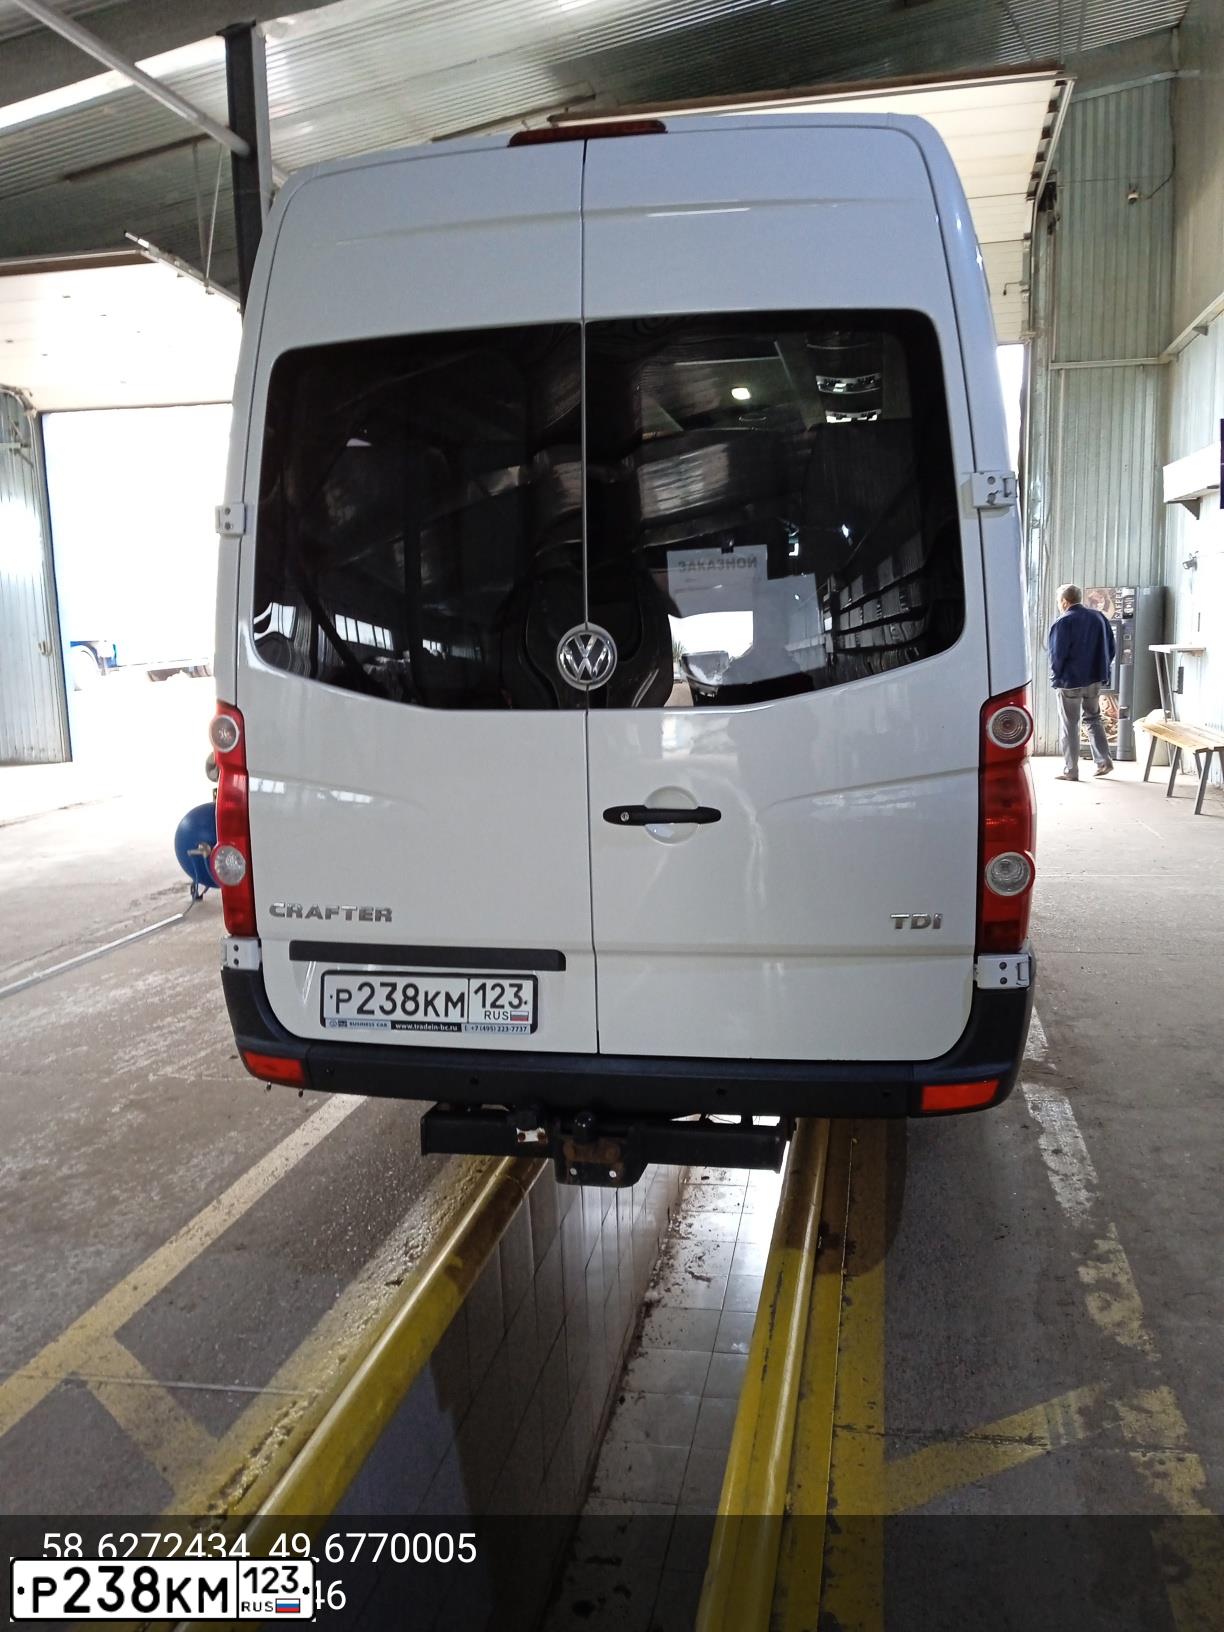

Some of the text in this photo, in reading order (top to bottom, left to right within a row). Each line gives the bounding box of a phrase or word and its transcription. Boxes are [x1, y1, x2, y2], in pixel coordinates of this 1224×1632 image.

[269, 902, 393, 922] CRAFTER
[473, 983, 524, 1009] 123
[484, 1011, 509, 1021] RUS
[395, 1023, 458, 1032] www.tradein-bc.ru
